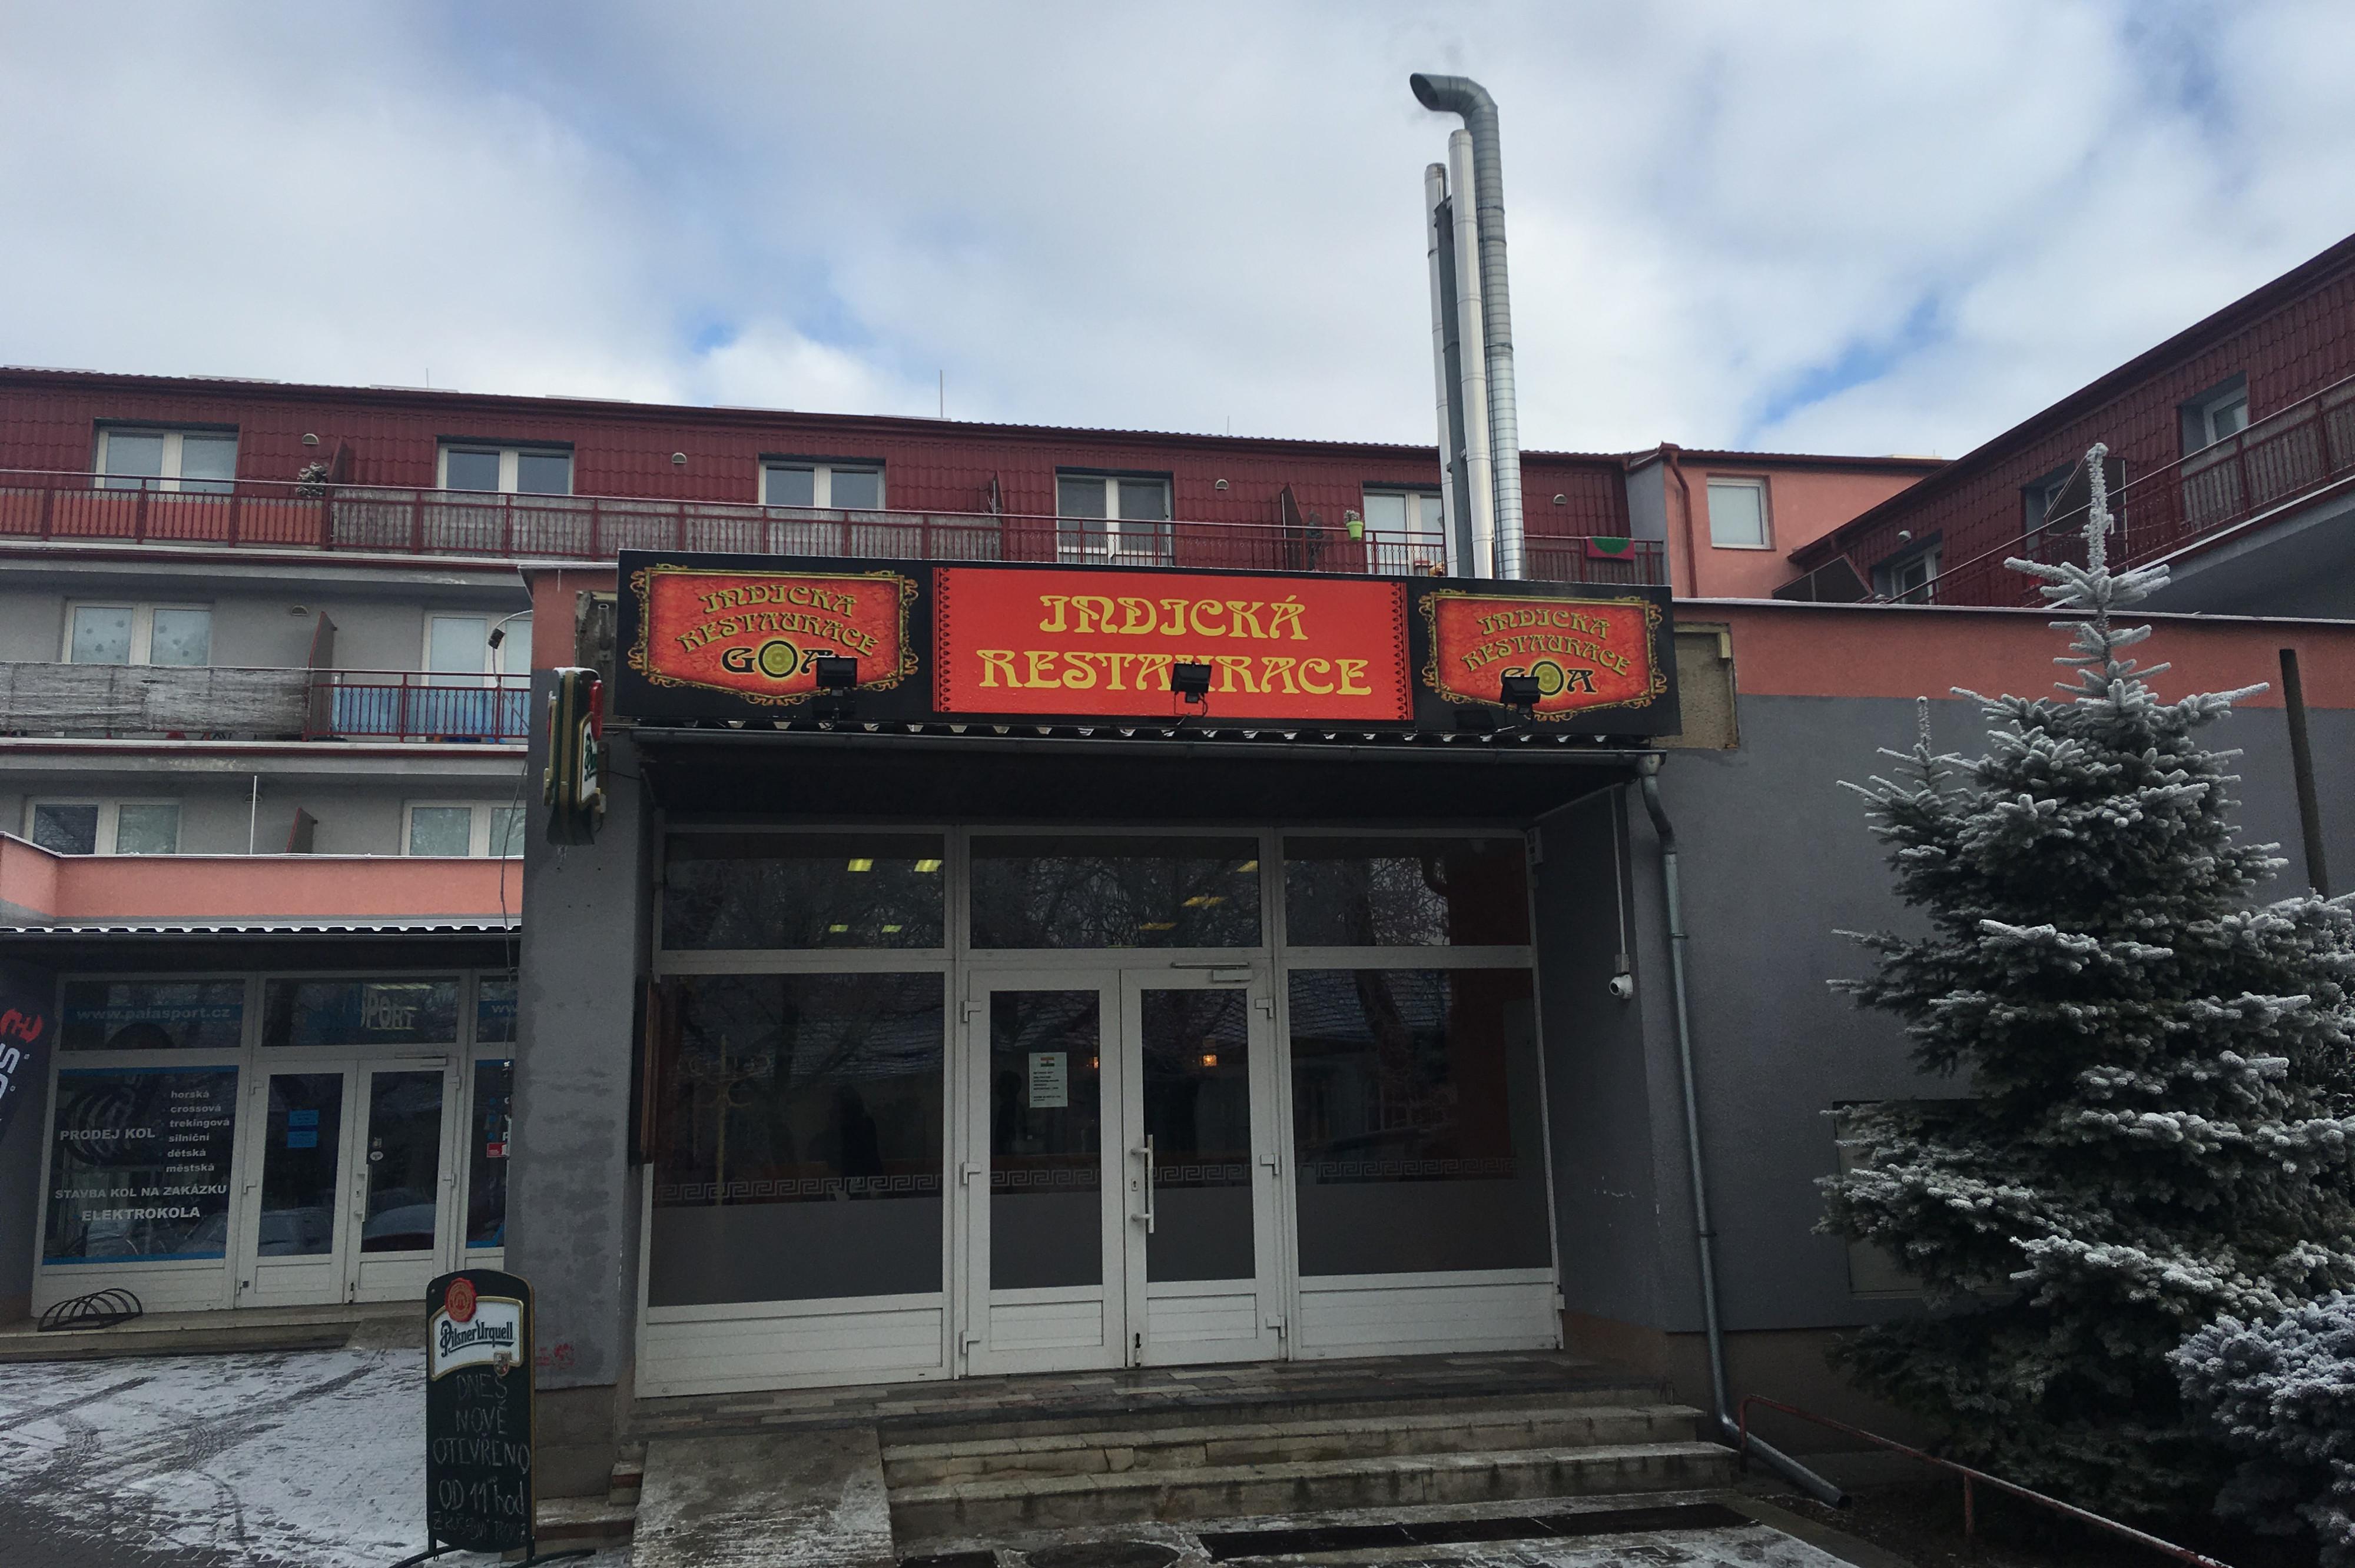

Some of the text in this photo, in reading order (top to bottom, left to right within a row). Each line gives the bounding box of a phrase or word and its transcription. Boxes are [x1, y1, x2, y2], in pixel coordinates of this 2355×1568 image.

[1039, 595, 1308, 640] INDICKÁ
[675, 612, 880, 657] RESTAURACE
[1461, 634, 1631, 676] RESTAURACE
[976, 649, 1372, 696] RESTARACE
[171, 1090, 210, 1099] horská
[170, 1103, 221, 1113] crossová
[170, 1118, 230, 1128] trekingová
[59, 1128, 155, 1141] PRODEJ KOL
[168, 1133, 210, 1142] silniční
[167, 1148, 206, 1158] dětská
[166, 1163, 215, 1172] městská
[55, 1183, 227, 1199] STAVBA KOL NA ZAKÁZKU
[81, 1207, 201, 1221] ELEKTROKOLA
[440, 1319, 513, 1357] Pilsner Urquell
[456, 1373, 508, 1400] DNES
[433, 1432, 530, 1474] OTEVŘENO
[439, 1479, 464, 1510] OD
[494, 1480, 526, 1515] hod
